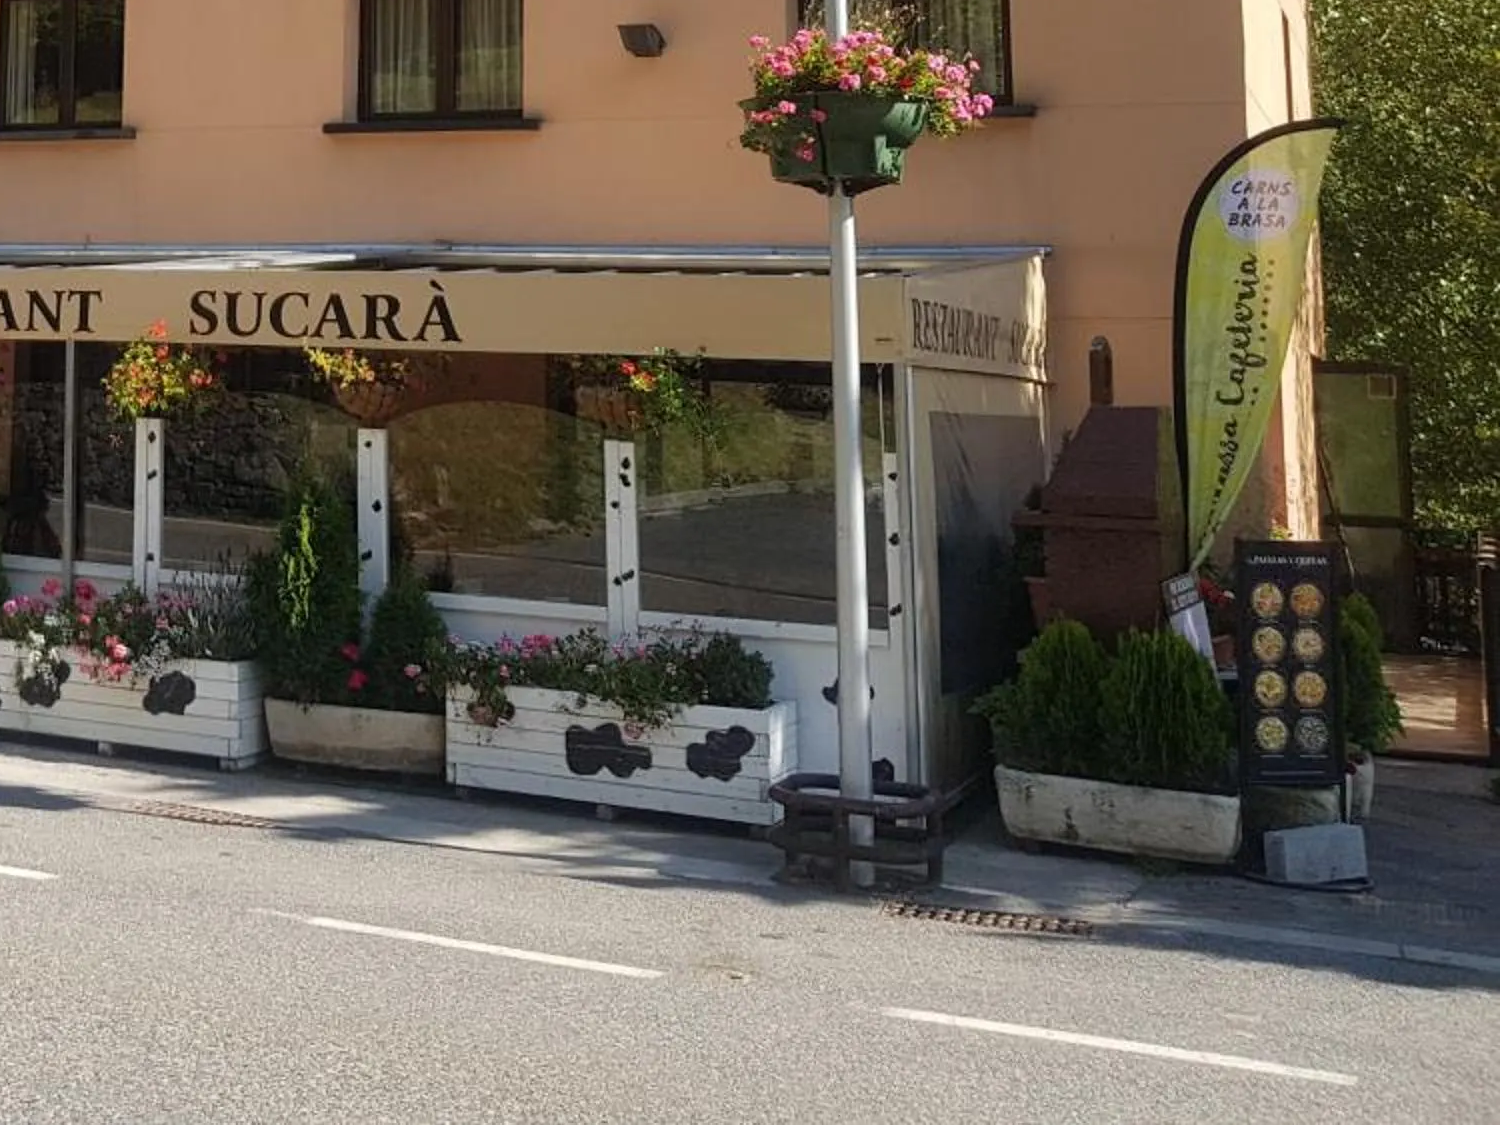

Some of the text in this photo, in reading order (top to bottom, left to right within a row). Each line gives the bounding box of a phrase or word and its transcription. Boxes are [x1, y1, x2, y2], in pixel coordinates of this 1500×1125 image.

[1231, 179, 1293, 196] CARNS
[1237, 197, 1280, 212] A LA
[1227, 212, 1286, 229] BRASA
[188, 279, 463, 343] SUCARÀ
[911, 298, 1001, 361] RESTAURANT
[1215, 251, 1265, 407] Cafeteria
